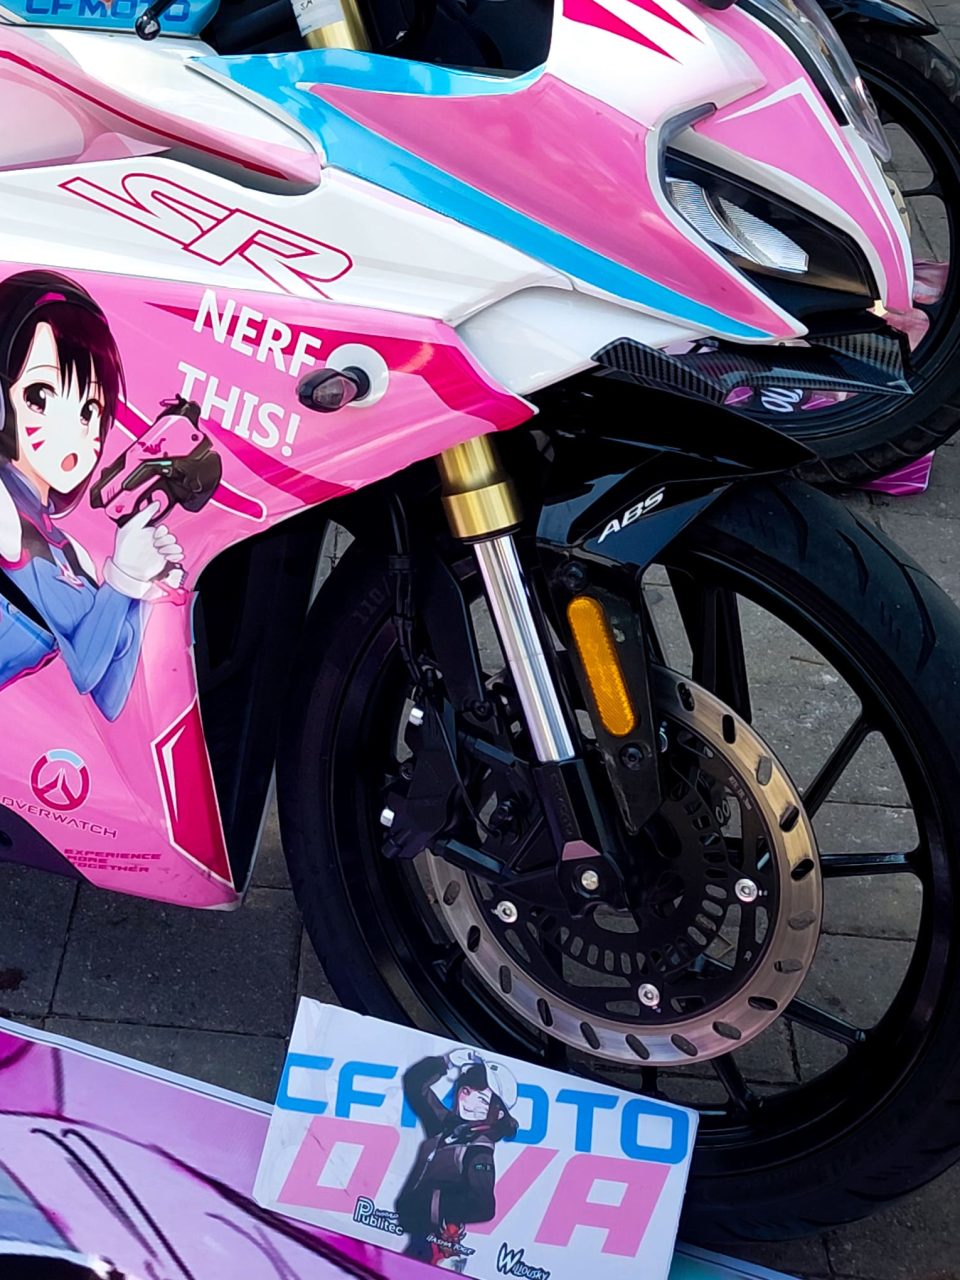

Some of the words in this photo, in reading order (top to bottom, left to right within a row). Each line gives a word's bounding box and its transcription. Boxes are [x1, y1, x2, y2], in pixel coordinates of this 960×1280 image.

[192, 288, 322, 377] NERF
[177, 361, 301, 457] THIS!
[597, 486, 666, 543] ABS
[2, 796, 117, 838] OVERWATCH
[64, 849, 161, 860] EXPERIENCE
[354, 1196, 404, 1235] Publitec
